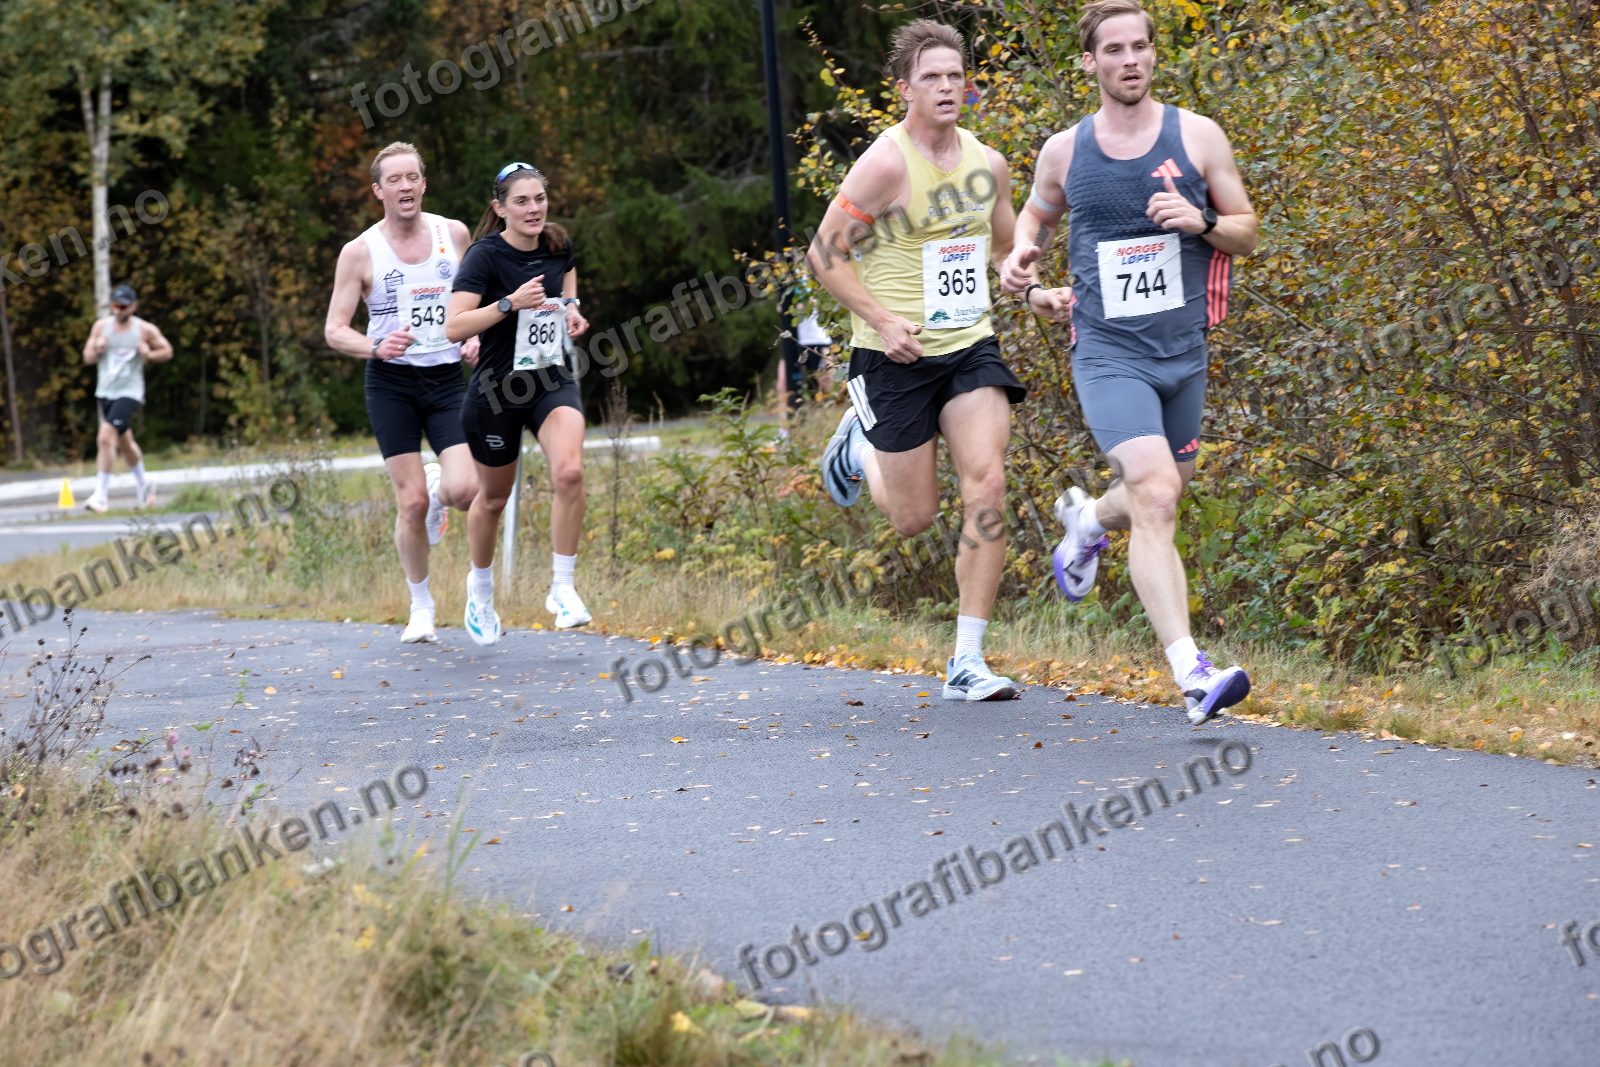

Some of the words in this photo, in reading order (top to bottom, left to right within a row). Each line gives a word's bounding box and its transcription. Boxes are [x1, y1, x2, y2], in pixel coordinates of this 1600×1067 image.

[938, 244, 976, 254] NORGES
[1115, 242, 1166, 256] NORGES
[943, 253, 971, 262] LØPET
[1121, 252, 1159, 265] LØPET
[938, 268, 976, 296] 365
[1116, 269, 1167, 301] 744
[410, 286, 446, 295] NORGES
[411, 305, 445, 328] 543
[528, 321, 557, 345] 868
